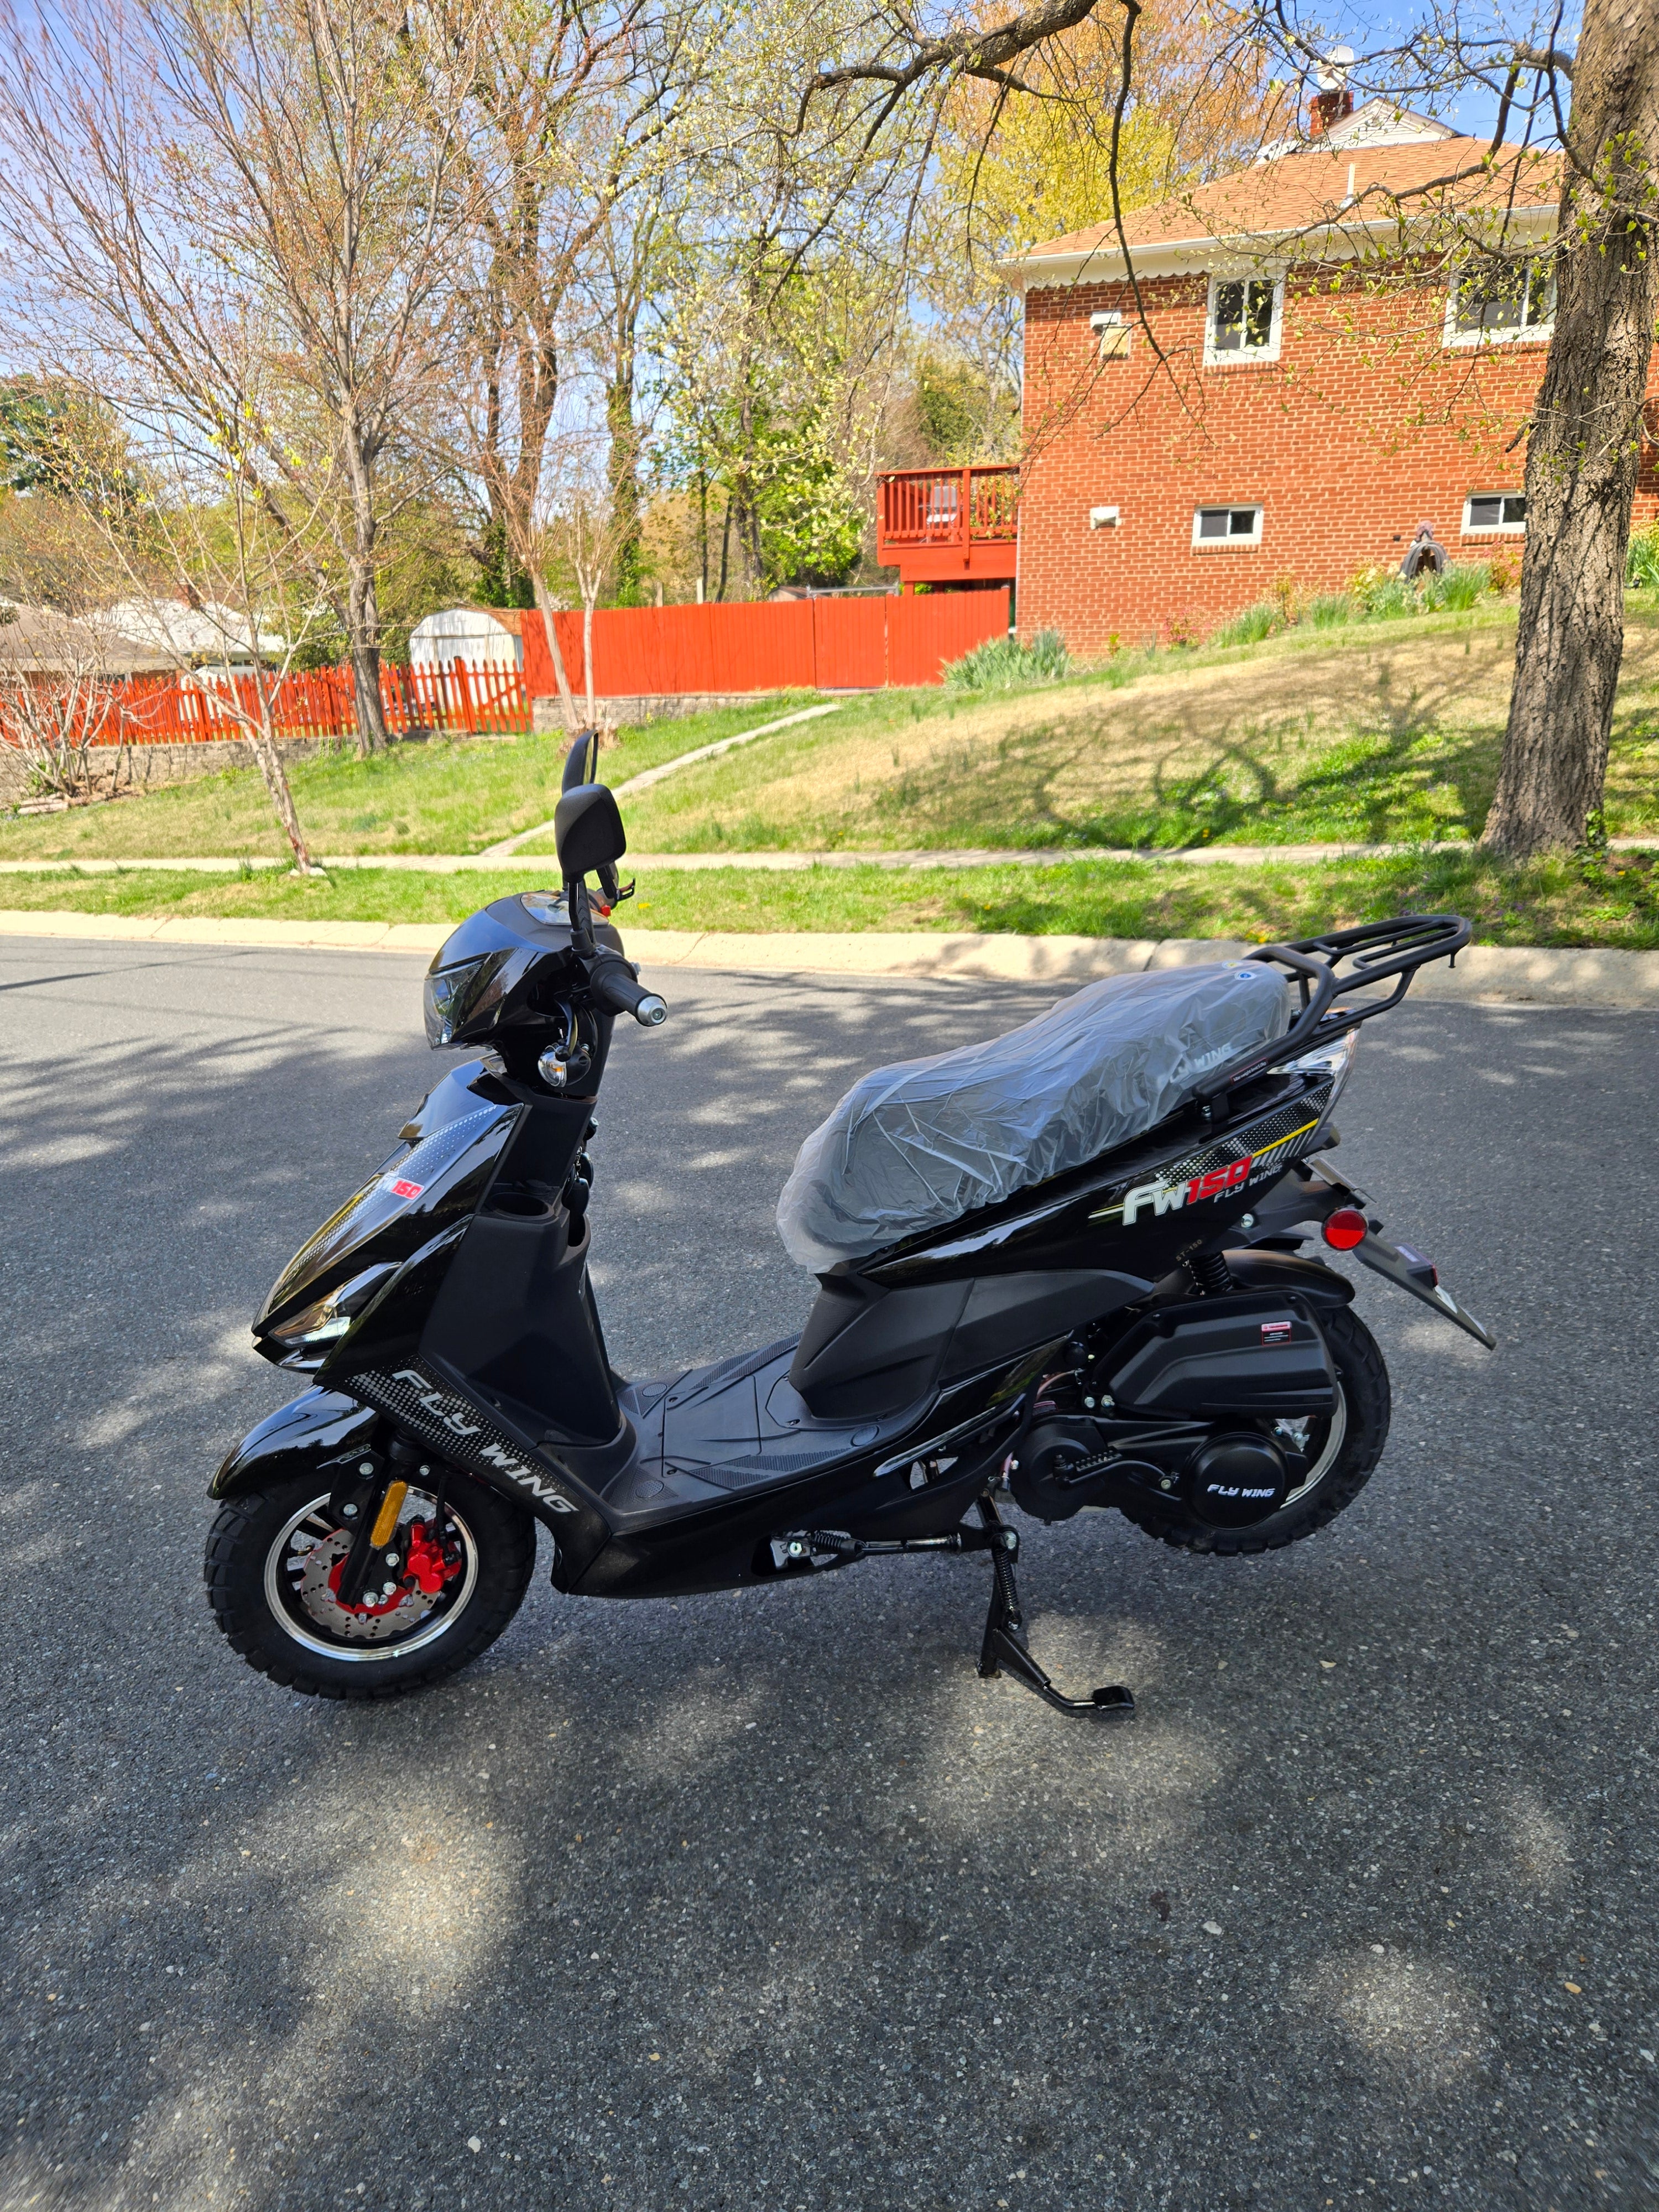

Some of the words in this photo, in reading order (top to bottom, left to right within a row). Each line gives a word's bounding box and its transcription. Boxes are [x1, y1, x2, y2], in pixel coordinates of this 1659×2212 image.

[1213, 1182, 1245, 1203] FLY
[1249, 1162, 1283, 1186] WING
[1176, 1239, 1202, 1261] ST-150
[392, 1369, 482, 1436] FLY
[479, 1442, 579, 1513] WING
[1207, 1484, 1240, 1497] FLY
[1241, 1488, 1276, 1498] WING
